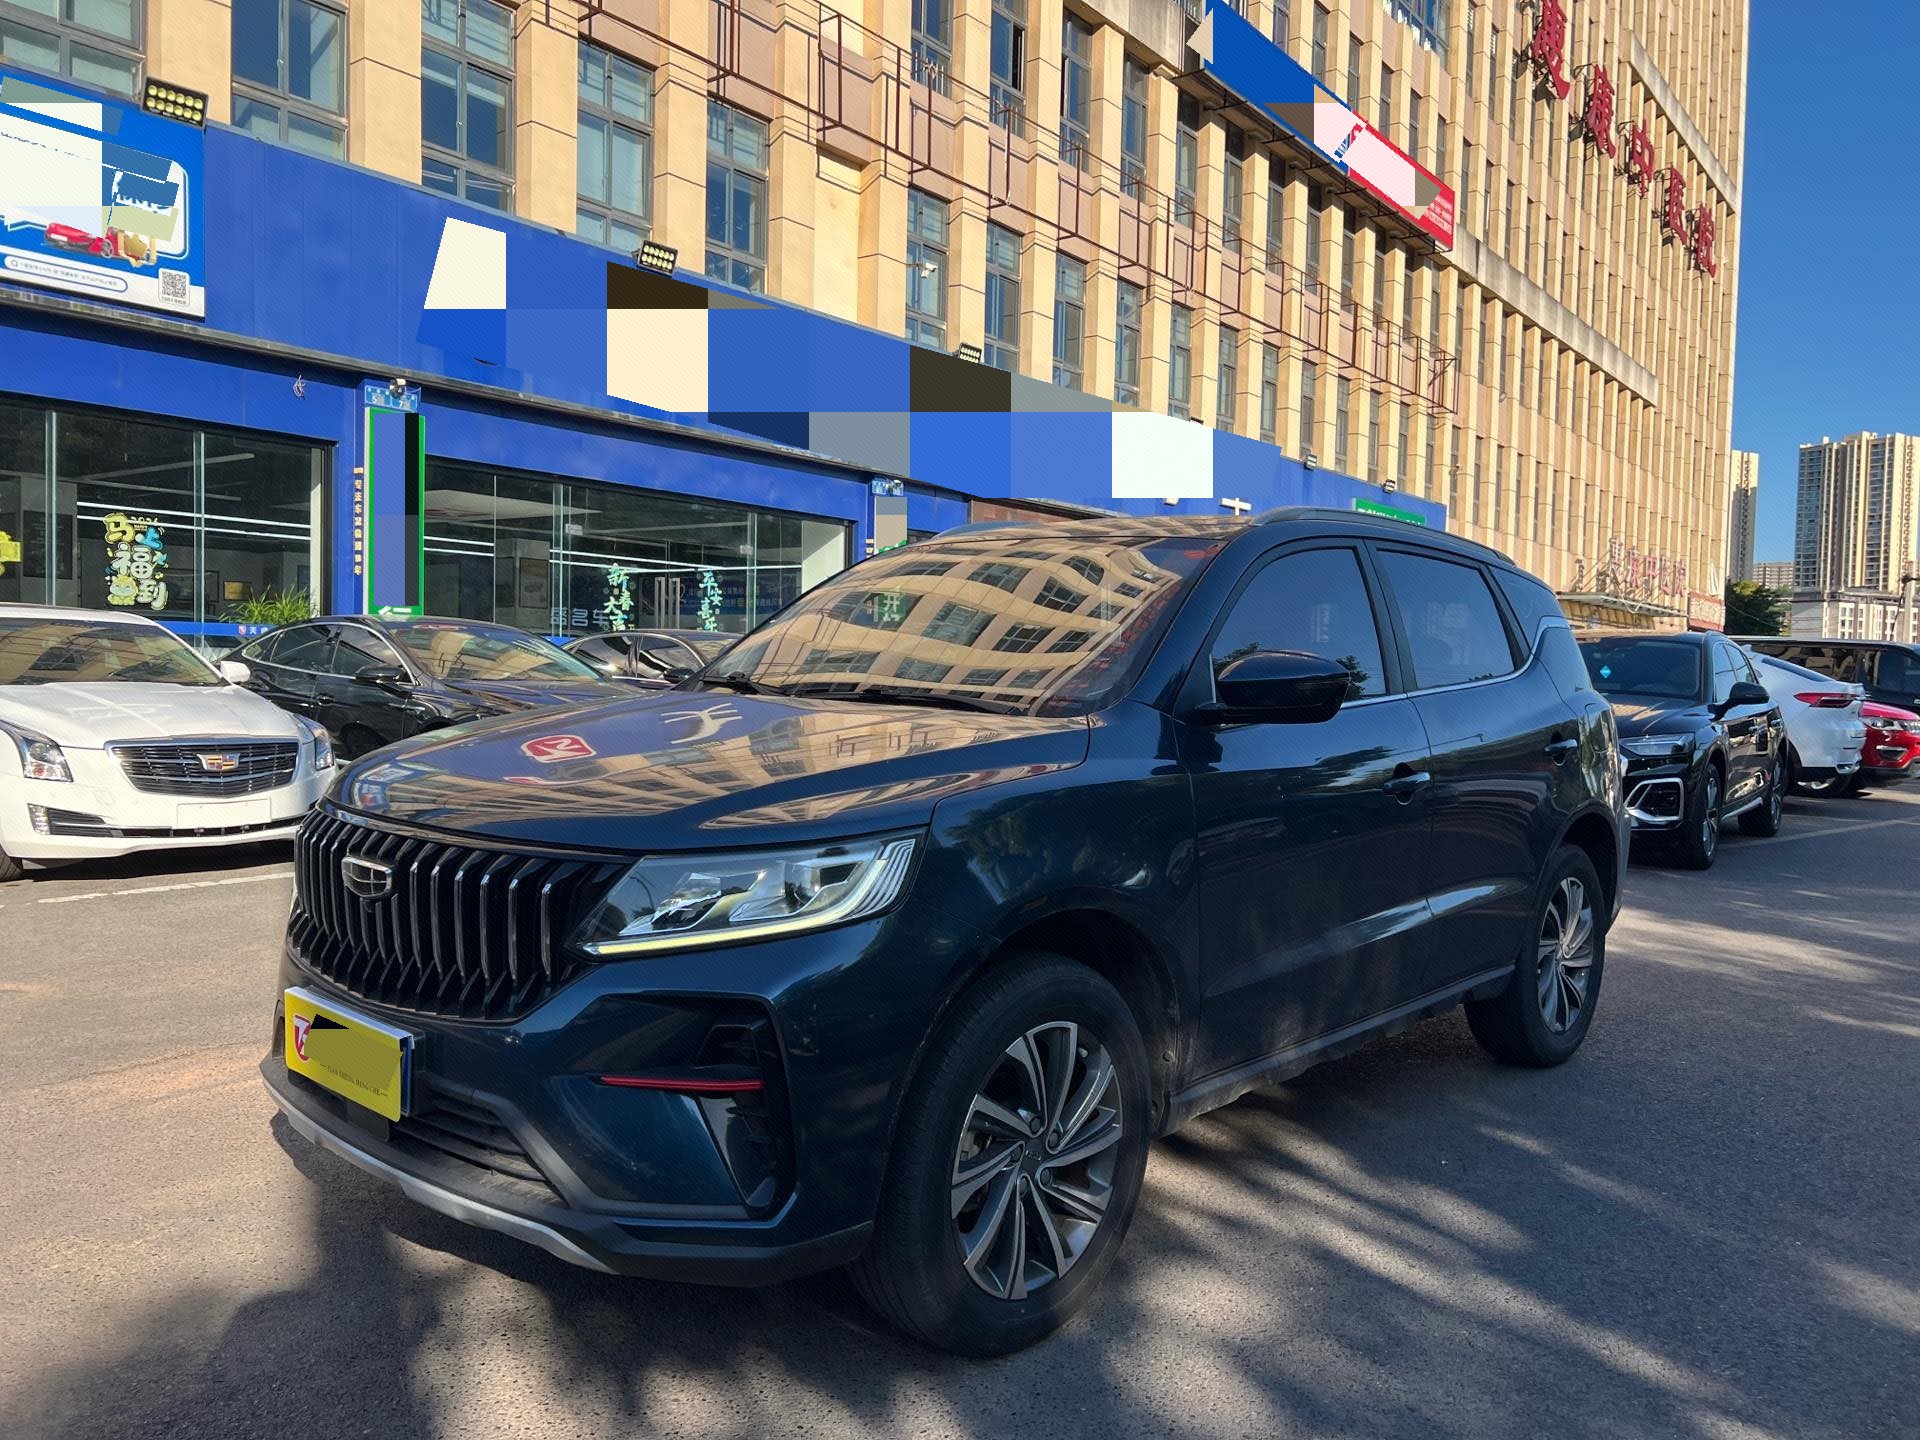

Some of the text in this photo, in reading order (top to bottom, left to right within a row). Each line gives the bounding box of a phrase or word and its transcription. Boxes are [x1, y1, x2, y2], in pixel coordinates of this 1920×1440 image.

[603, 563, 634, 631] 新春大吉
[697, 571, 723, 632] 平安喜乐
